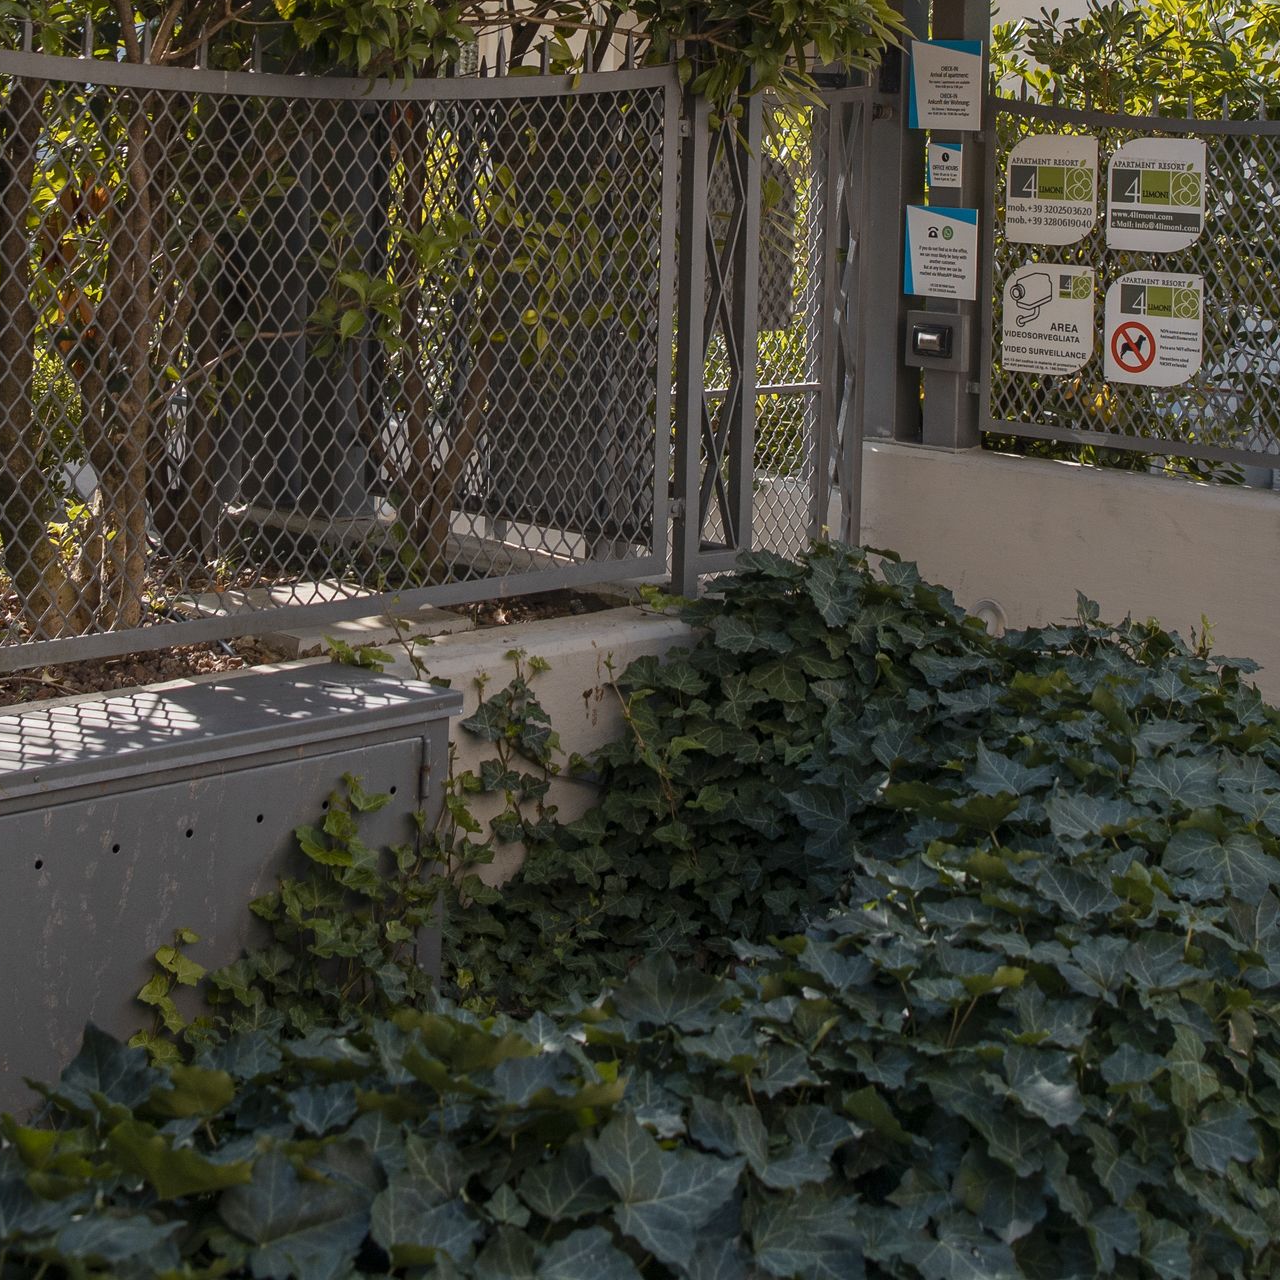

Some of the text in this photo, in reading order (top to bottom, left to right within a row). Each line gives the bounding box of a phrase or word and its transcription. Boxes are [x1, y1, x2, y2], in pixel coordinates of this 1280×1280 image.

[1011, 157, 1079, 167] APARTMENT RESORT
[1113, 161, 1186, 170] APARTMENT RESORT
[1022, 173, 1064, 198] 4 LIMONI
[1124, 176, 1169, 203] 4 LIMONI
[1044, 205, 1093, 216] 3202503620
[1112, 211, 1173, 221] www.4limoni.com
[1044, 218, 1092, 228] 3280619040
[1122, 277, 1186, 287] APARTMENT RESORT
[1132, 291, 1146, 315] 4
[1050, 323, 1079, 333] AREA
[1004, 330, 1080, 343] VIDEOSORVEGLIATA
[1004, 345, 1087, 360] VIDEO SURVEILLANCE
